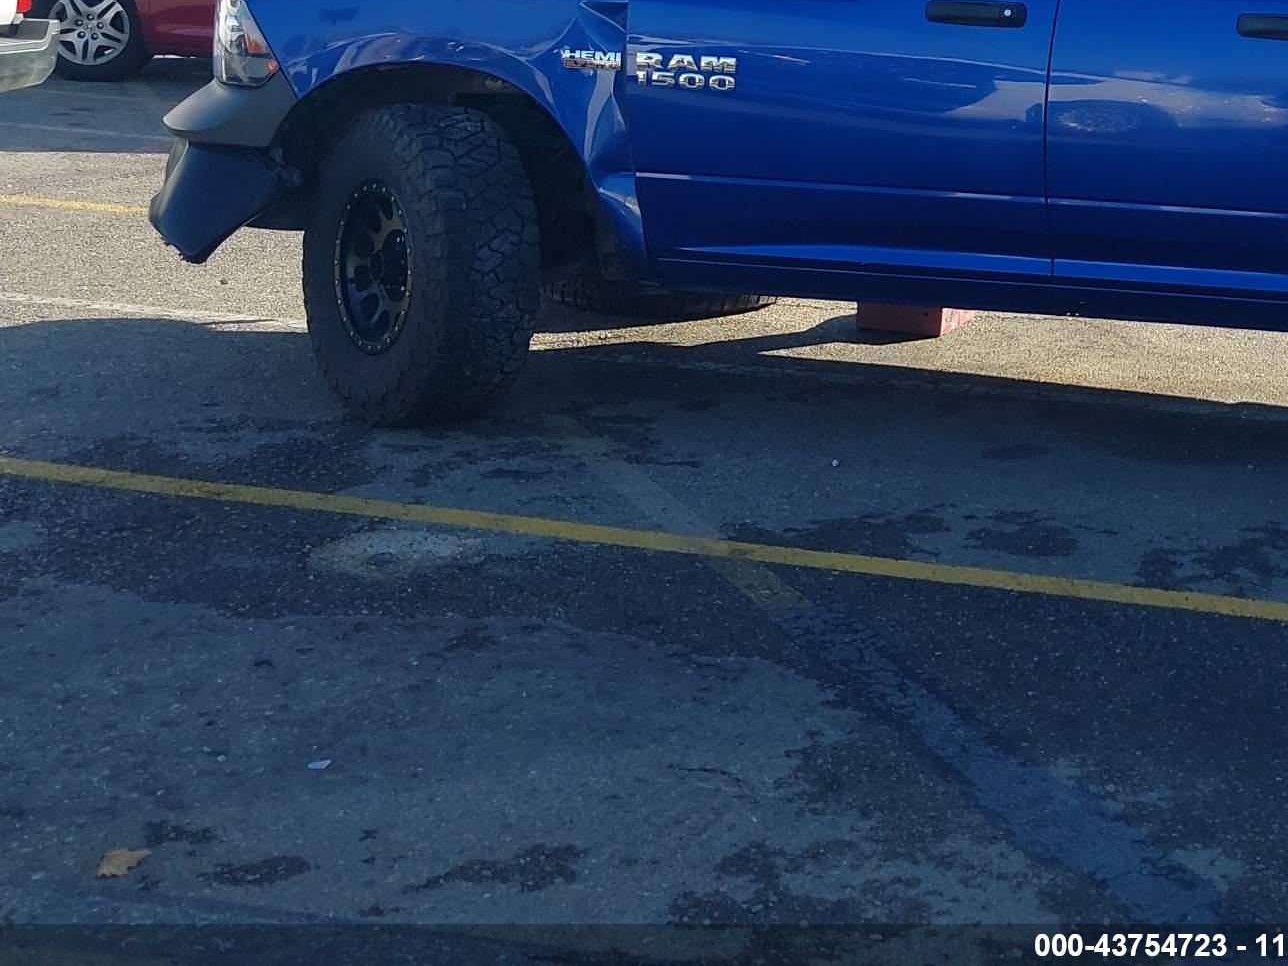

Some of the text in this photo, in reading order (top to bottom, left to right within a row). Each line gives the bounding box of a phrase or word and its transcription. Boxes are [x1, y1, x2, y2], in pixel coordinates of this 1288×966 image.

[562, 49, 622, 62] HEMI
[635, 51, 738, 74] RAM
[635, 70, 736, 91] 1500
